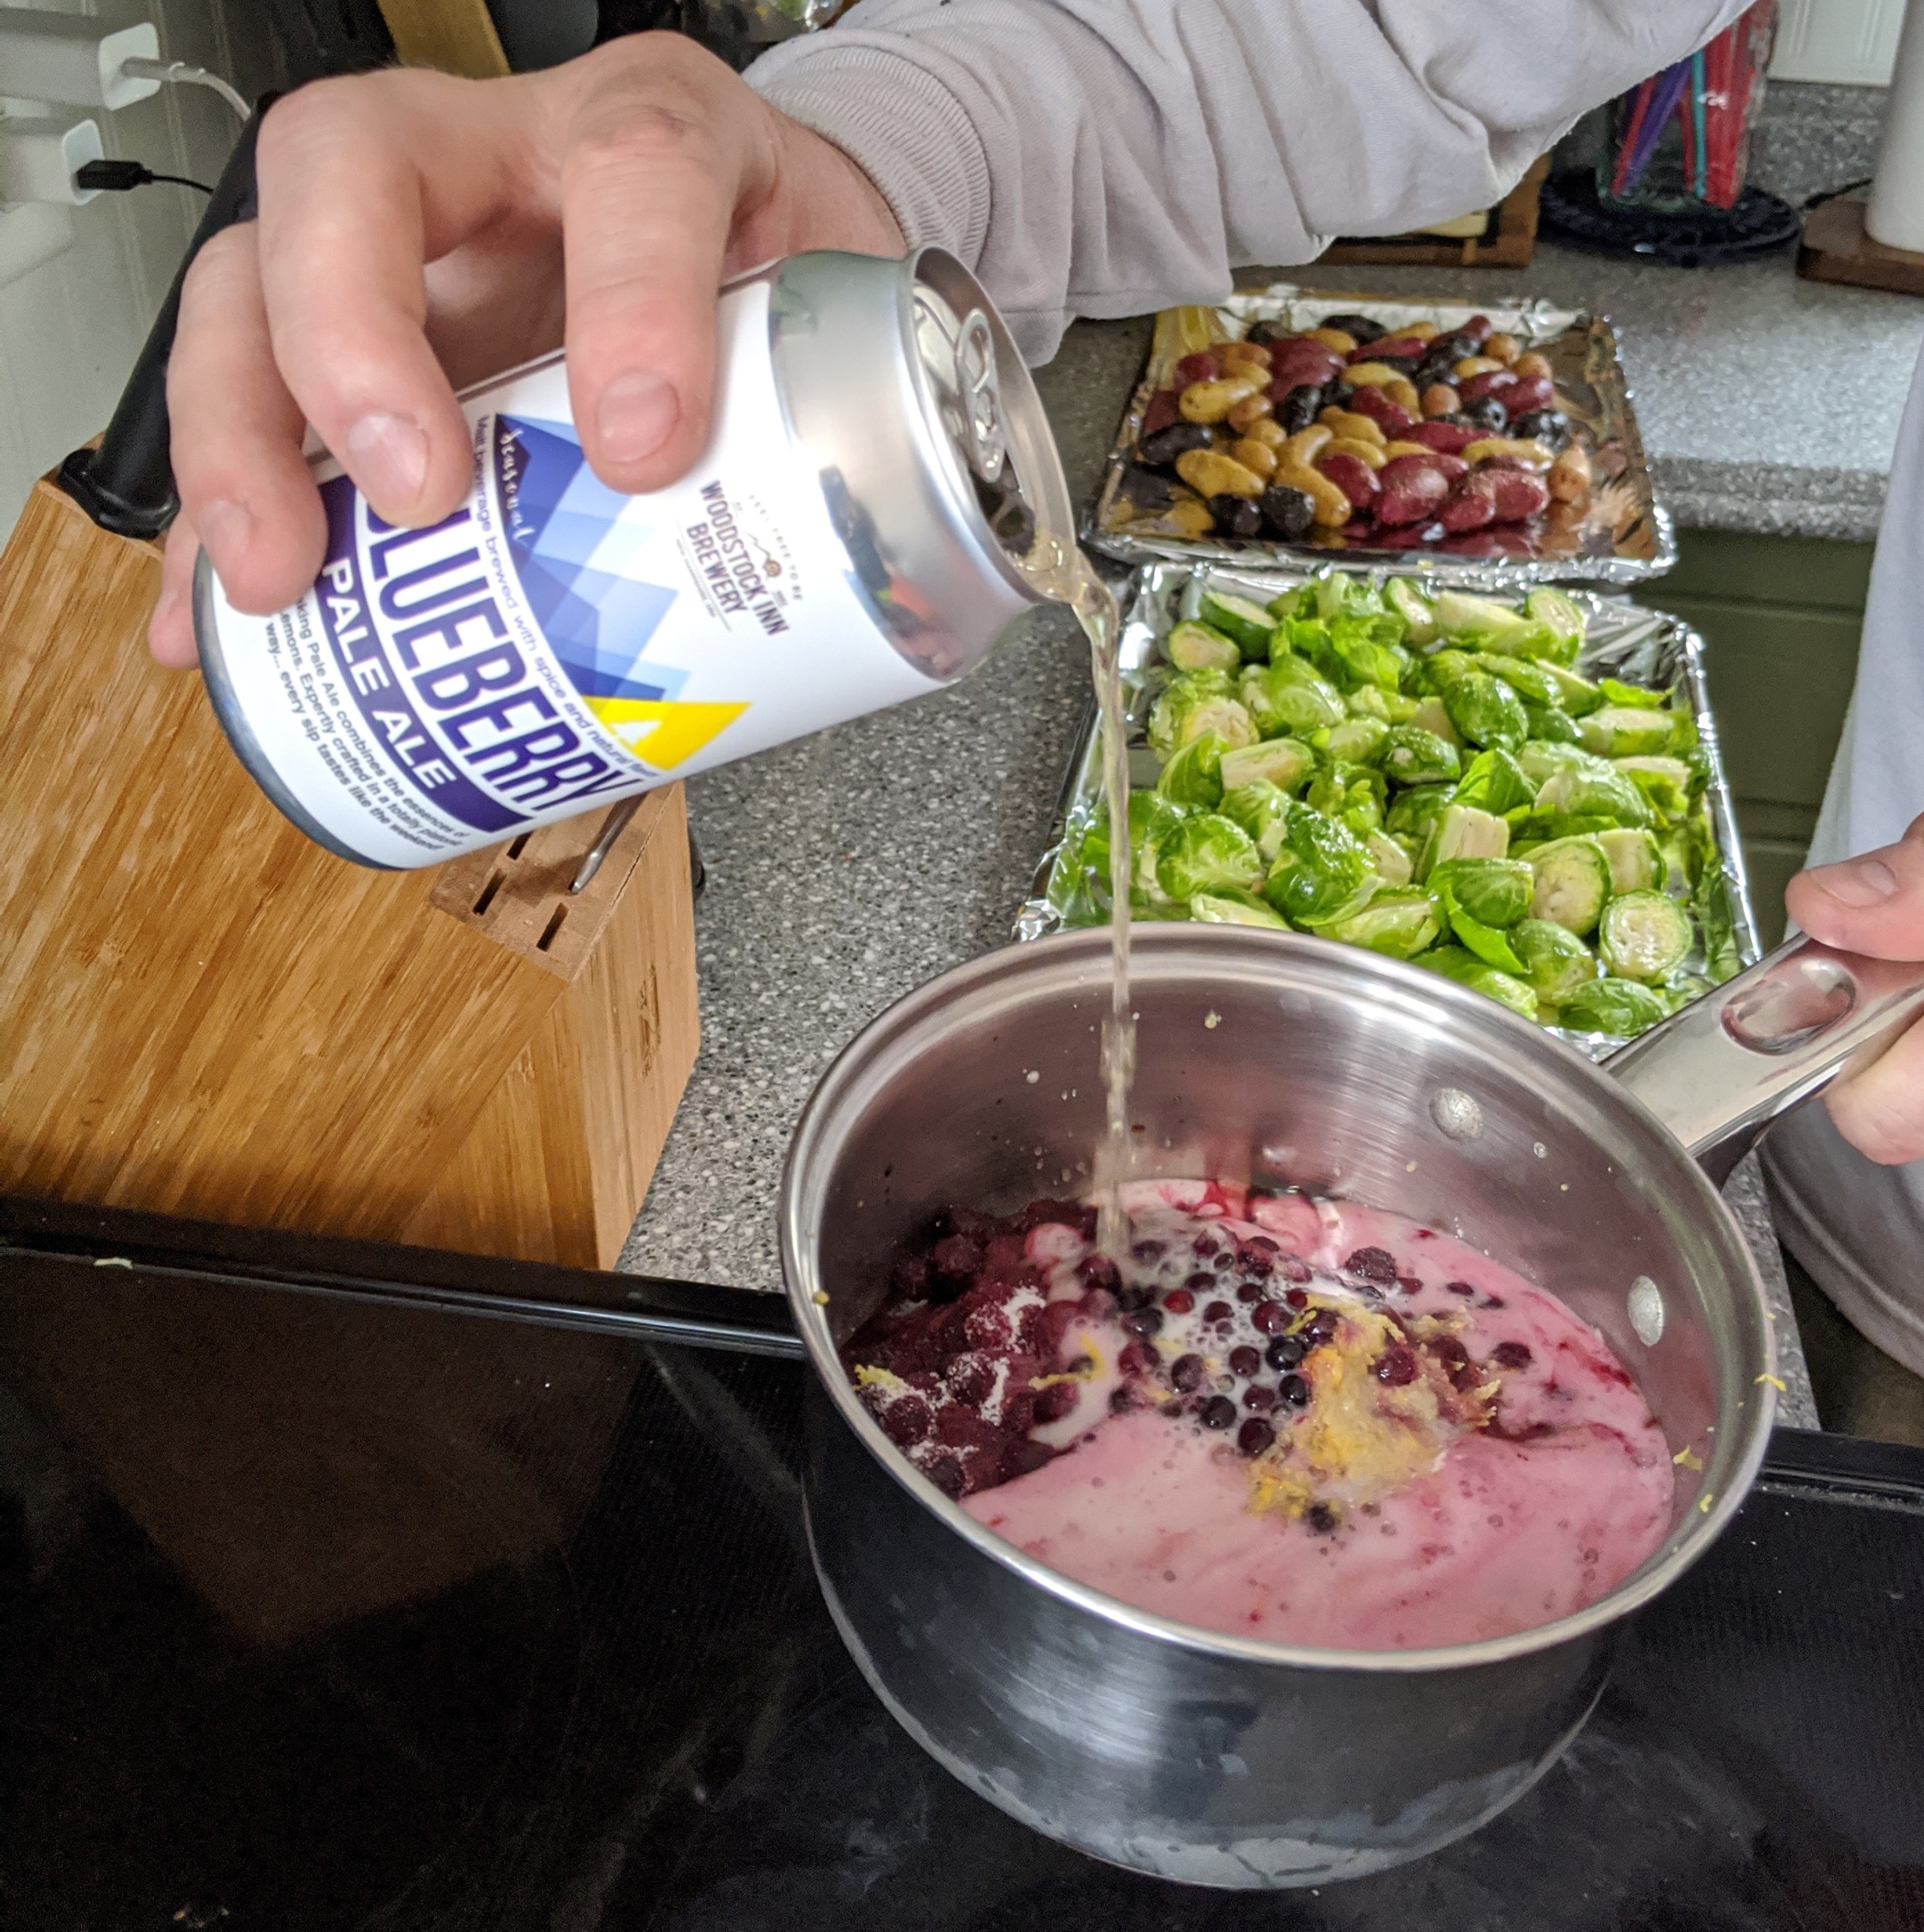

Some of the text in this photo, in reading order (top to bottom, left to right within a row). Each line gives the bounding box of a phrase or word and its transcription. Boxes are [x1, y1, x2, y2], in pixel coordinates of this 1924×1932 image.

[485, 537, 519, 609] brewed
[514, 615, 537, 651] with
[534, 657, 566, 698] spice
[564, 703, 593, 728] and
[686, 521, 748, 614] BREWERY
[700, 479, 790, 636] WOODSTOCK INN
[307, 642, 325, 677] Pale
[322, 682, 340, 706] Ale
[337, 711, 386, 777] combines
[383, 778, 405, 797] the
[322, 556, 457, 789] PALE ALE
[367, 503, 644, 811] LUEBERRY
[281, 671, 306, 713] every
[301, 718, 320, 742] sip
[317, 743, 351, 786] tastes
[348, 786, 372, 808] like
[370, 808, 391, 824] the
[300, 672, 337, 734] Expertly
[332, 737, 373, 782] crafted
[366, 783, 381, 795] in
[387, 803, 423, 829] totally
